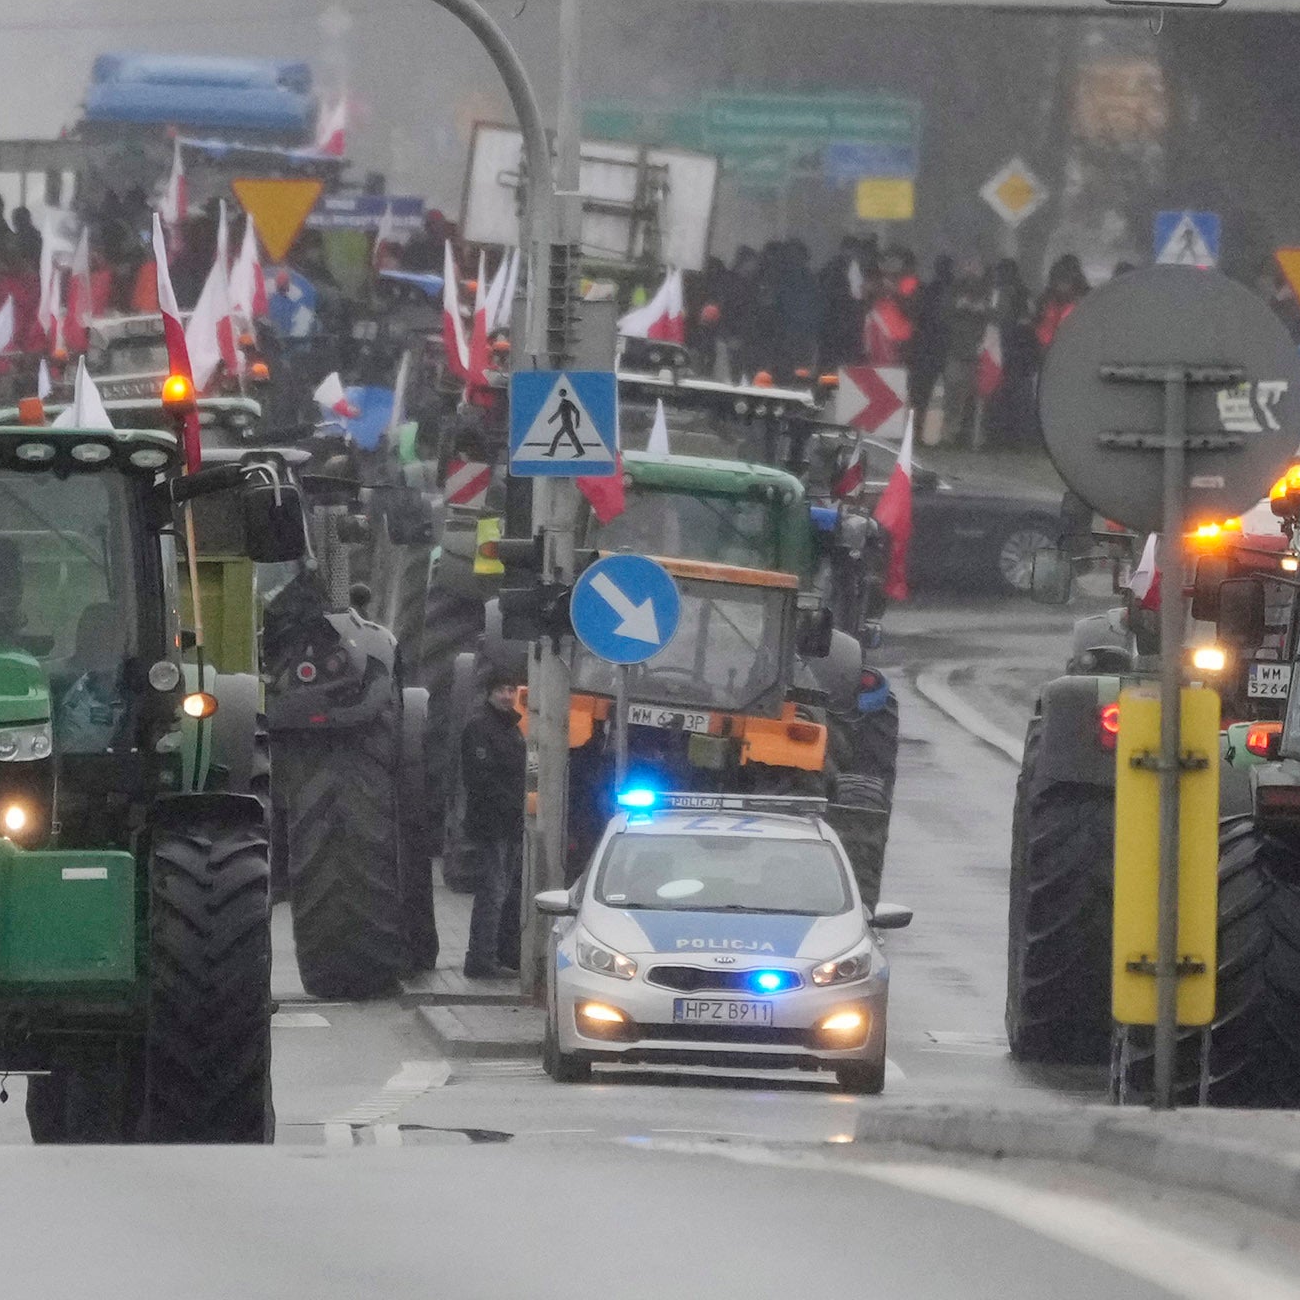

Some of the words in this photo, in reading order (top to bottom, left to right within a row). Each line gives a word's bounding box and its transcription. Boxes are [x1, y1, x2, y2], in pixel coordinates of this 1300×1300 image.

[1262, 668, 1281, 680] WM
[632, 707, 652, 724] WM
[672, 796, 722, 808] POLICJA
[675, 938, 775, 952] POLICJA
[715, 956, 735, 964] KIA
[686, 1002, 723, 1019] HPZ
[728, 1003, 768, 1021] B911
